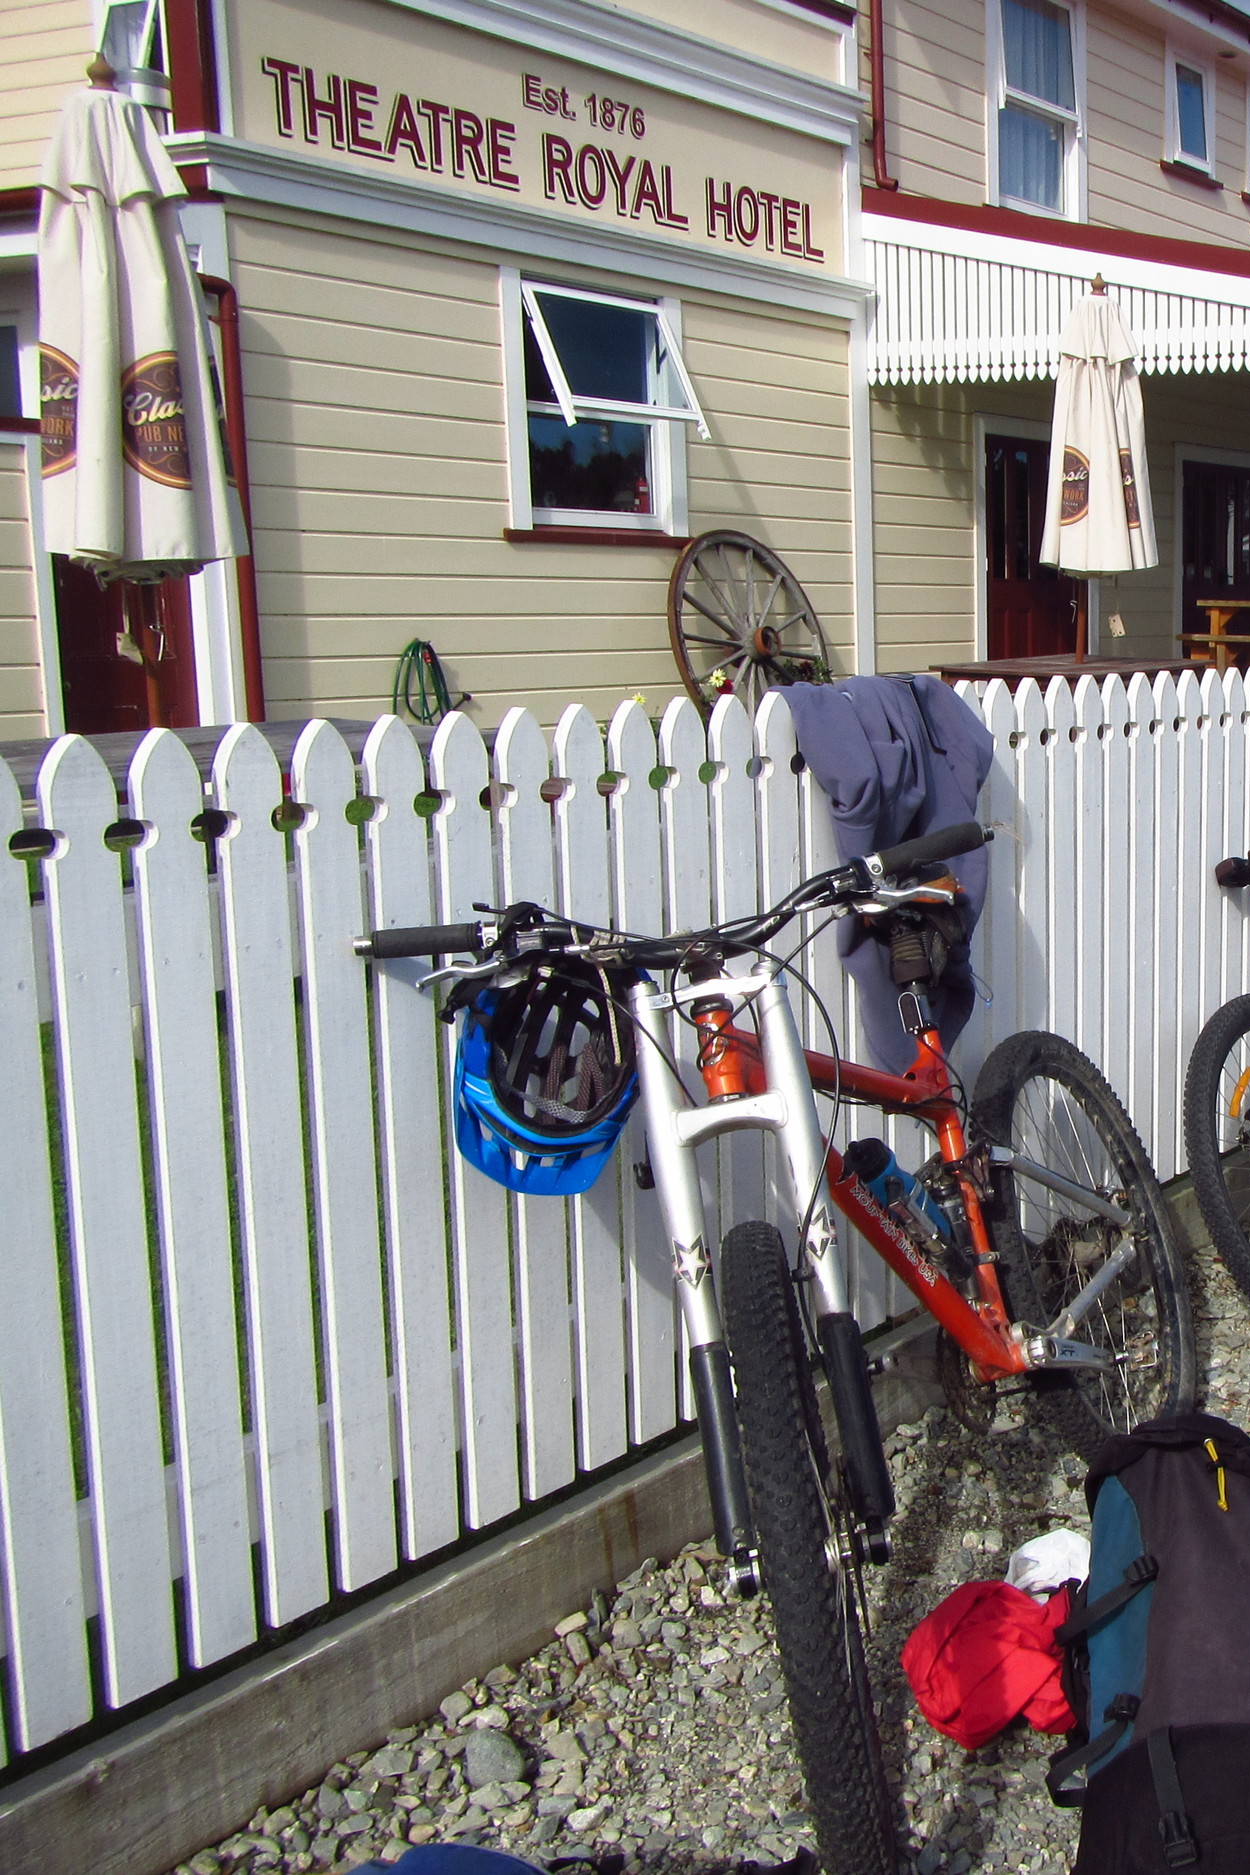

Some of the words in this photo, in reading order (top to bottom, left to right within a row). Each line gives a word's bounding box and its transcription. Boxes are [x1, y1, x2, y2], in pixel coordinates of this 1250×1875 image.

[522, 73, 576, 121] Est.
[584, 93, 646, 139] 1876
[261, 56, 521, 193] THEATRE
[541, 132, 690, 232] ROYAL
[704, 177, 825, 263] HOTEL
[850, 1184, 900, 1242] MOUNTAIN
[917, 1261, 939, 1288] USA
